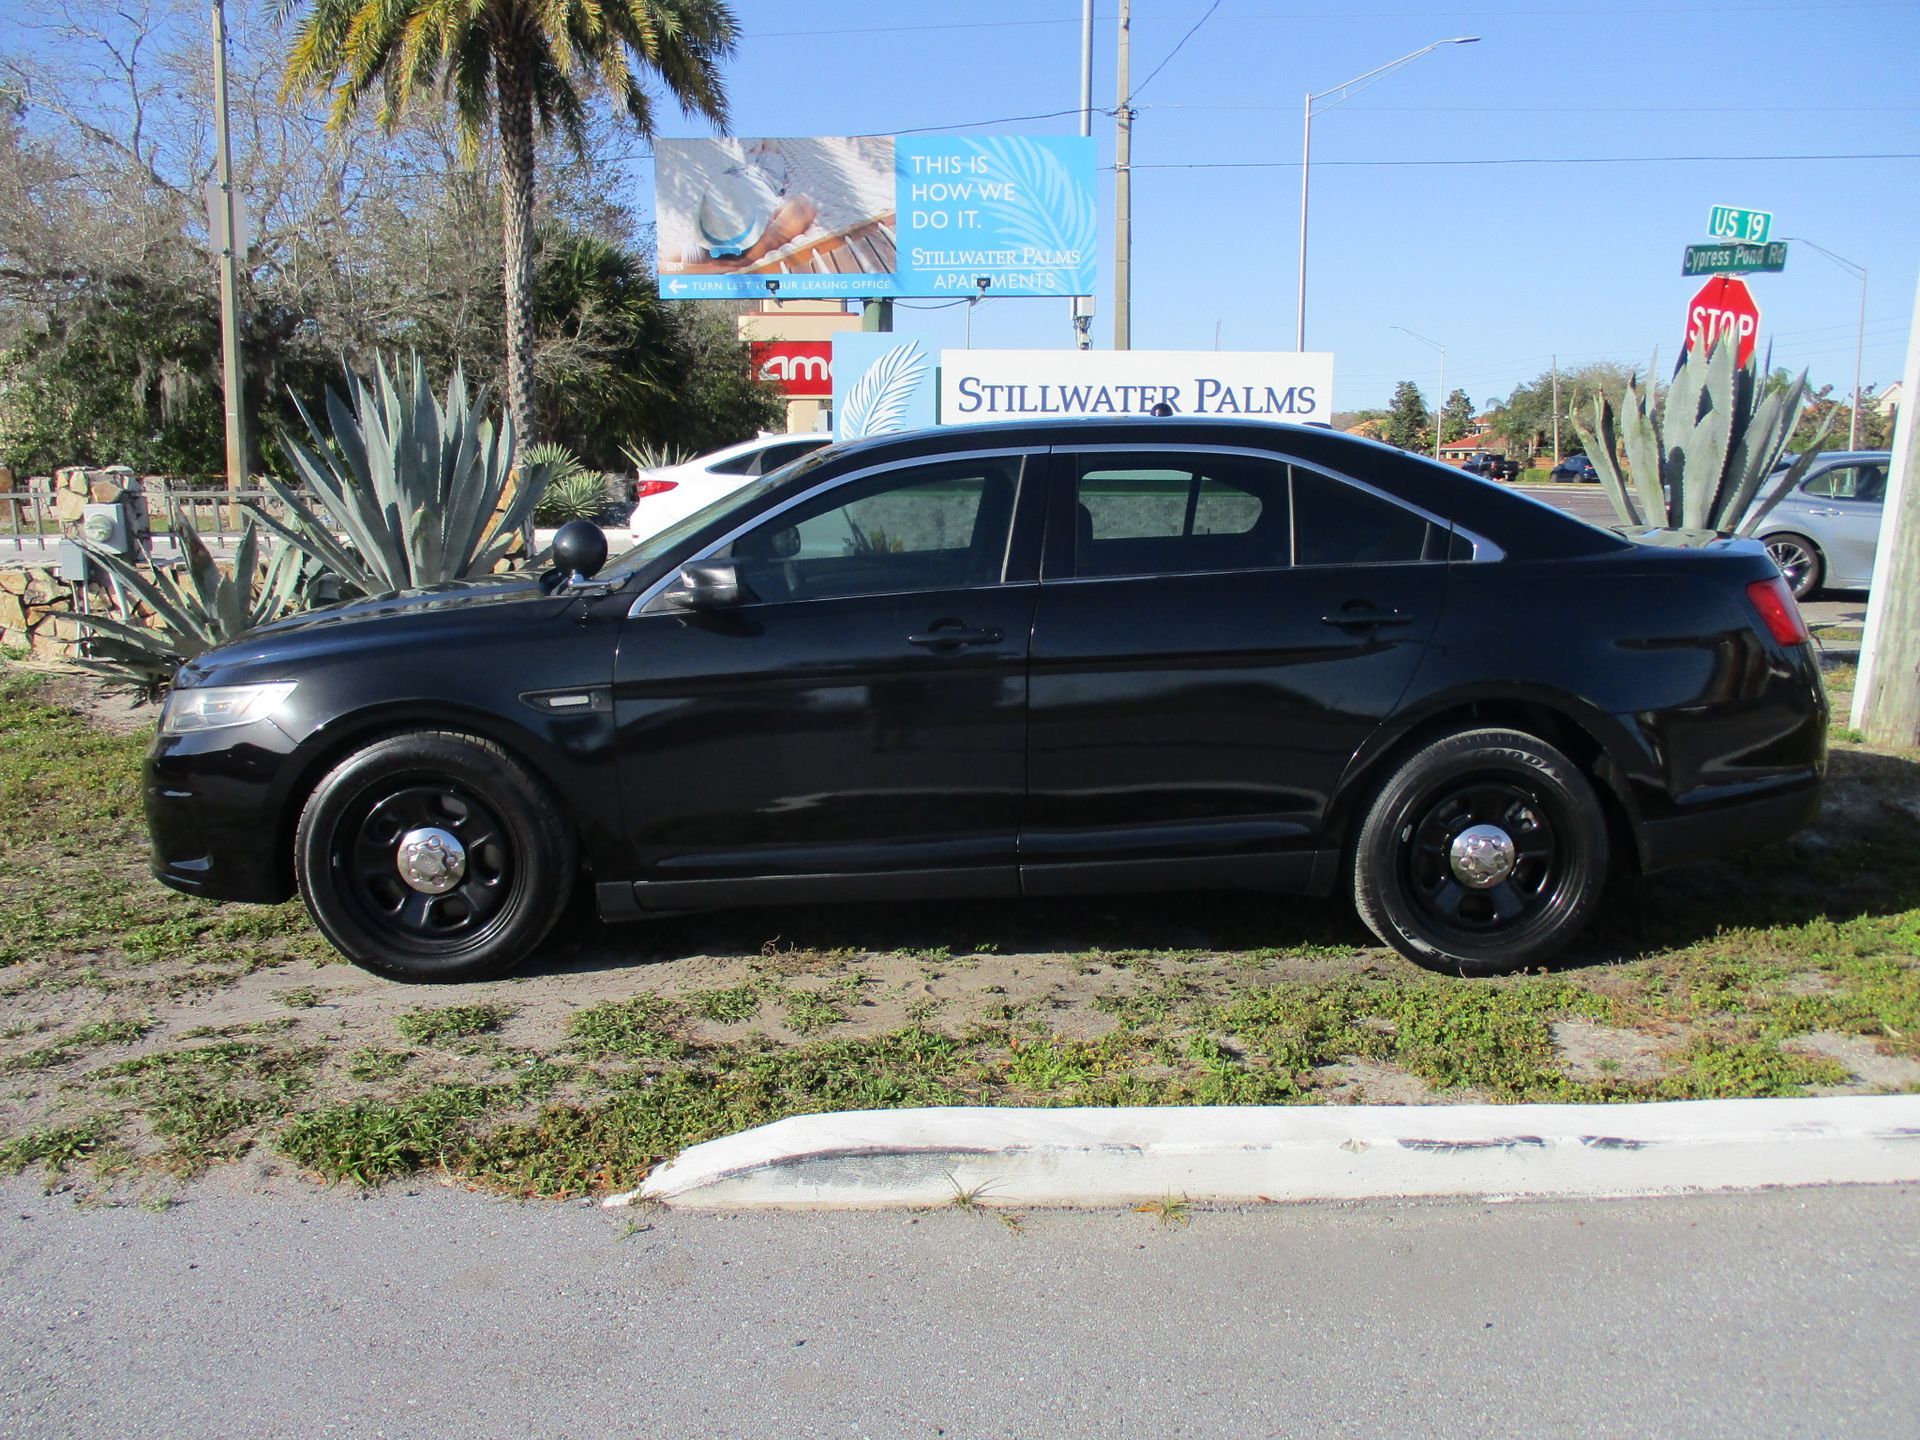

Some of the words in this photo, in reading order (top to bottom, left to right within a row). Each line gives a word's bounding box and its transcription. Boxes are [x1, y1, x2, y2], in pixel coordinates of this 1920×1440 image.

[911, 155, 961, 174] THIS
[970, 155, 988, 174] IS
[912, 183, 972, 201] HOW
[978, 183, 1016, 201] WE
[912, 210, 949, 229] DO
[958, 210, 982, 229] IT.
[1715, 208, 1739, 237] US
[1745, 213, 1764, 241] 19
[912, 247, 1016, 265] STILLWATER
[1023, 248, 1081, 264] PALMS
[1685, 247, 1730, 273] Cypress
[1733, 245, 1765, 265] Pond
[1768, 243, 1786, 264] Rd
[692, 281, 722, 291] TURN
[727, 281, 751, 291] LEFT
[802, 281, 848, 290] LEASING
[852, 280, 890, 290] OFFICE
[1689, 306, 1754, 346] STOP
[759, 355, 832, 381] am
[958, 377, 1182, 413] STILLWATER
[1193, 378, 1316, 414] PALMS
